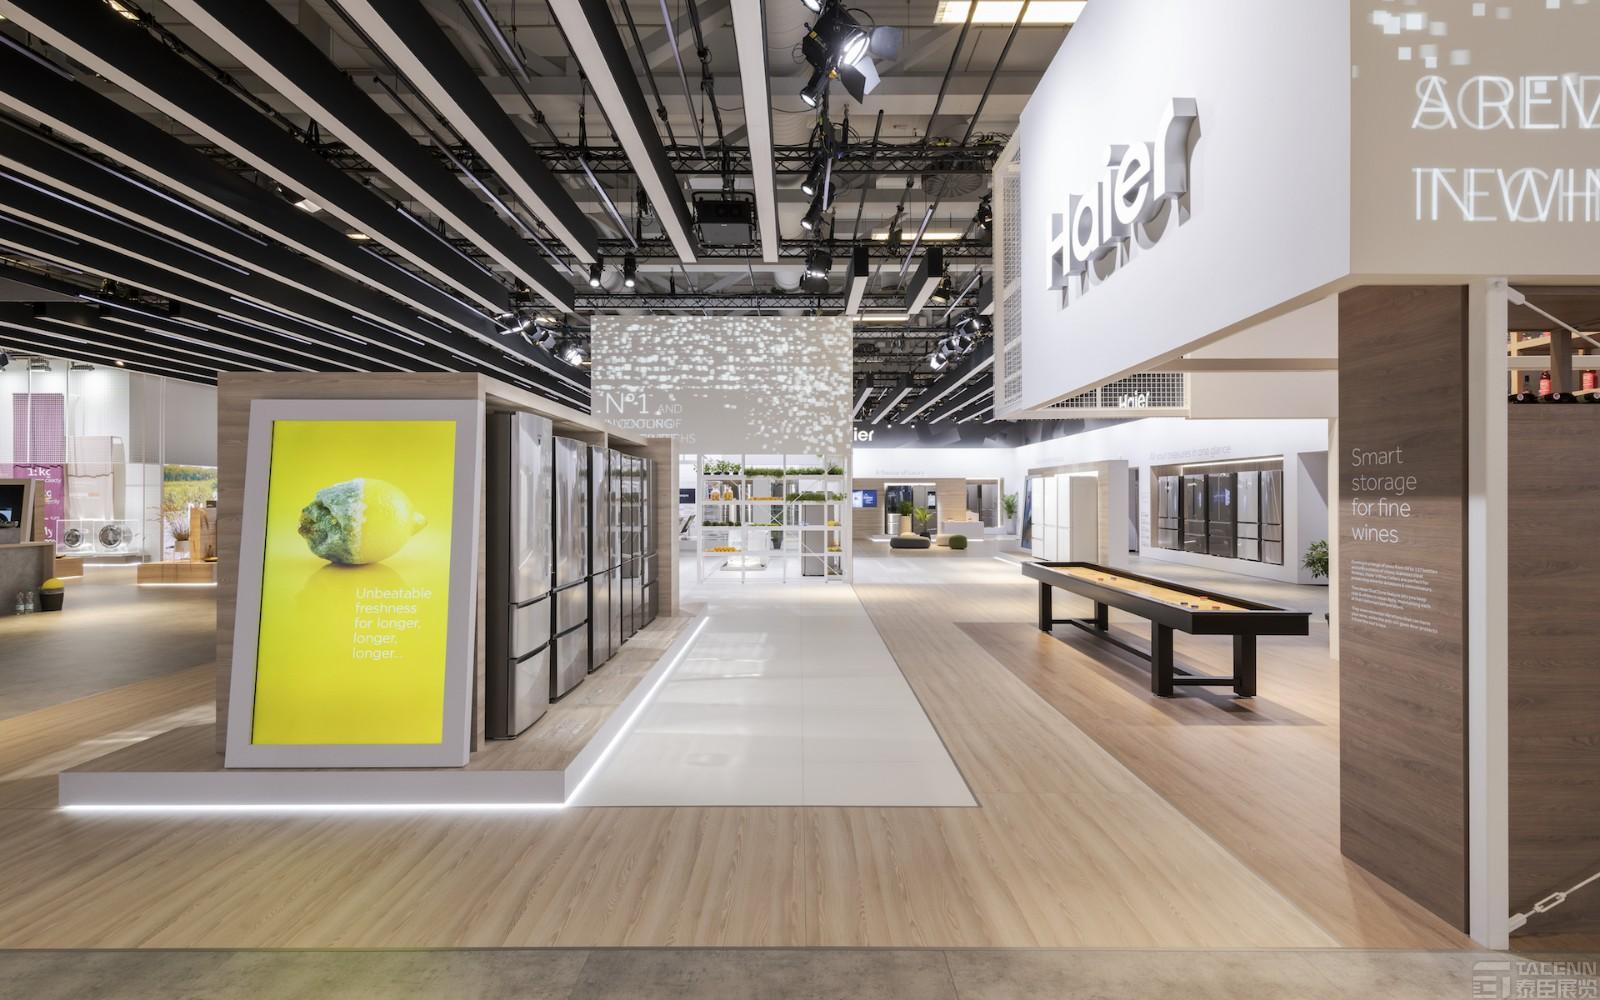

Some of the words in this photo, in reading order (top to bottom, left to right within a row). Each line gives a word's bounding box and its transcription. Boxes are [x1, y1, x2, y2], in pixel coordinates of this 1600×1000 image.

[1047, 97, 1202, 292] Haier
[1120, 390, 1150, 409] Haier
[854, 427, 874, 441] ier
[1351, 446, 1404, 467] Smart
[1351, 474, 1417, 496] storage
[1352, 498, 1375, 517] for
[1379, 498, 1411, 517] fine
[1352, 523, 1399, 543] wines
[356, 587, 432, 599] Unbeatable
[355, 602, 417, 614] freshness
[354, 617, 374, 629] for
[377, 617, 421, 631] longer,
